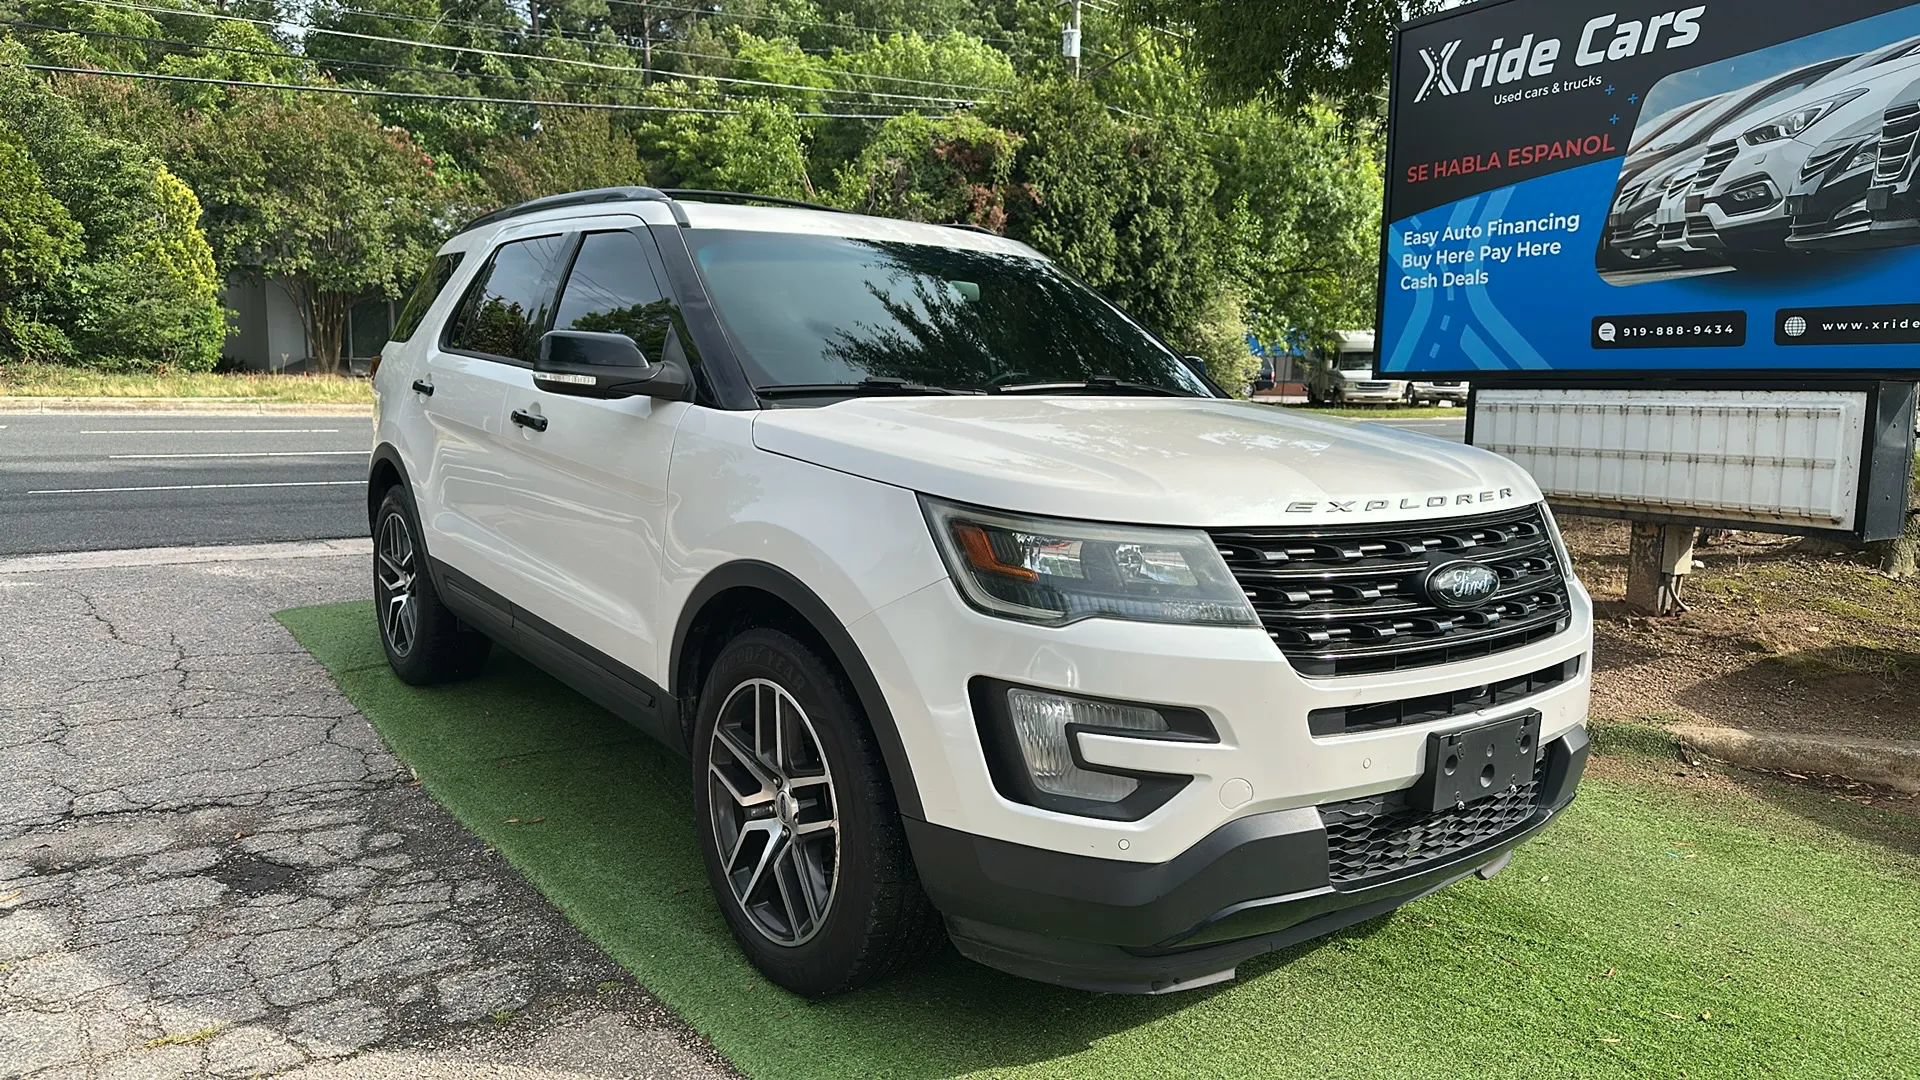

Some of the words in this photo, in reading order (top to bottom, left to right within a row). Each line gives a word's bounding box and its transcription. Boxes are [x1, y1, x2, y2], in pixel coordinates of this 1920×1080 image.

[1413, 33, 1561, 103] Xride
[1575, 5, 1706, 67] Cars
[1493, 87, 1522, 105] Used
[1524, 83, 1549, 99] cars
[1552, 82, 1560, 93] &
[1563, 75, 1602, 92] trucks
[1407, 164, 1429, 183] SE
[1433, 152, 1501, 178] HABLA
[1508, 134, 1616, 167] ESPANOL
[1404, 230, 1439, 248] Easy
[1442, 224, 1483, 241] Auto
[1487, 213, 1580, 237] Financing
[1402, 252, 1432, 270] Buy
[1436, 247, 1475, 264] Here
[1479, 246, 1513, 263] Pay
[1517, 240, 1562, 257] Here
[1401, 274, 1438, 290] Cash
[1442, 269, 1489, 287] Deals
[1623, 324, 1734, 337] 919-888-9434
[1285, 487, 1513, 513] EXPLORER
[1452, 569, 1491, 597] Ford
